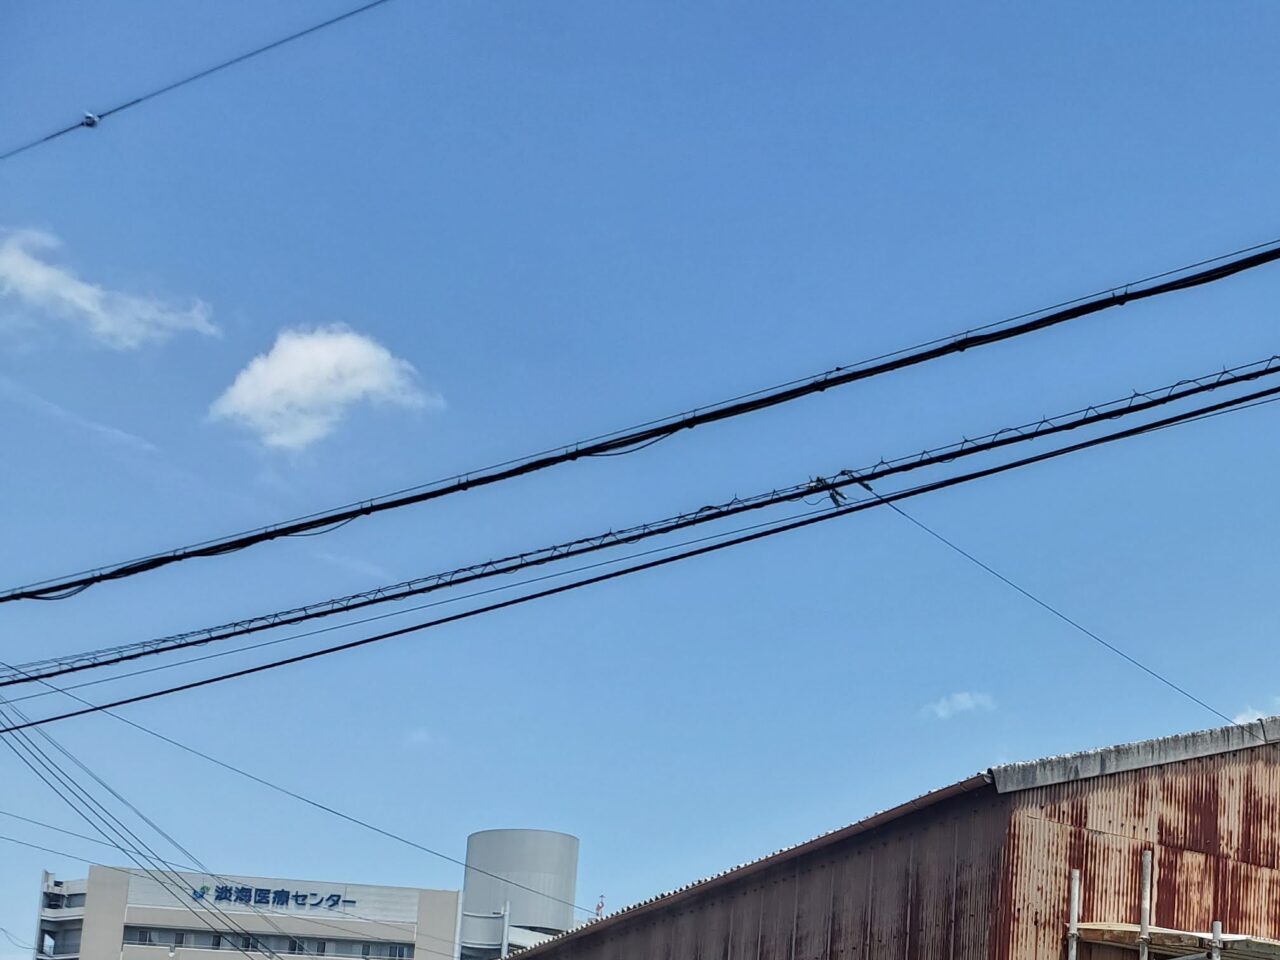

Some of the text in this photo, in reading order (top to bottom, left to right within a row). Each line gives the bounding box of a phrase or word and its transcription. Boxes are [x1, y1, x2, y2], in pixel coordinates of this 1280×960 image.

[214, 885, 357, 908] 淡海医療センター
